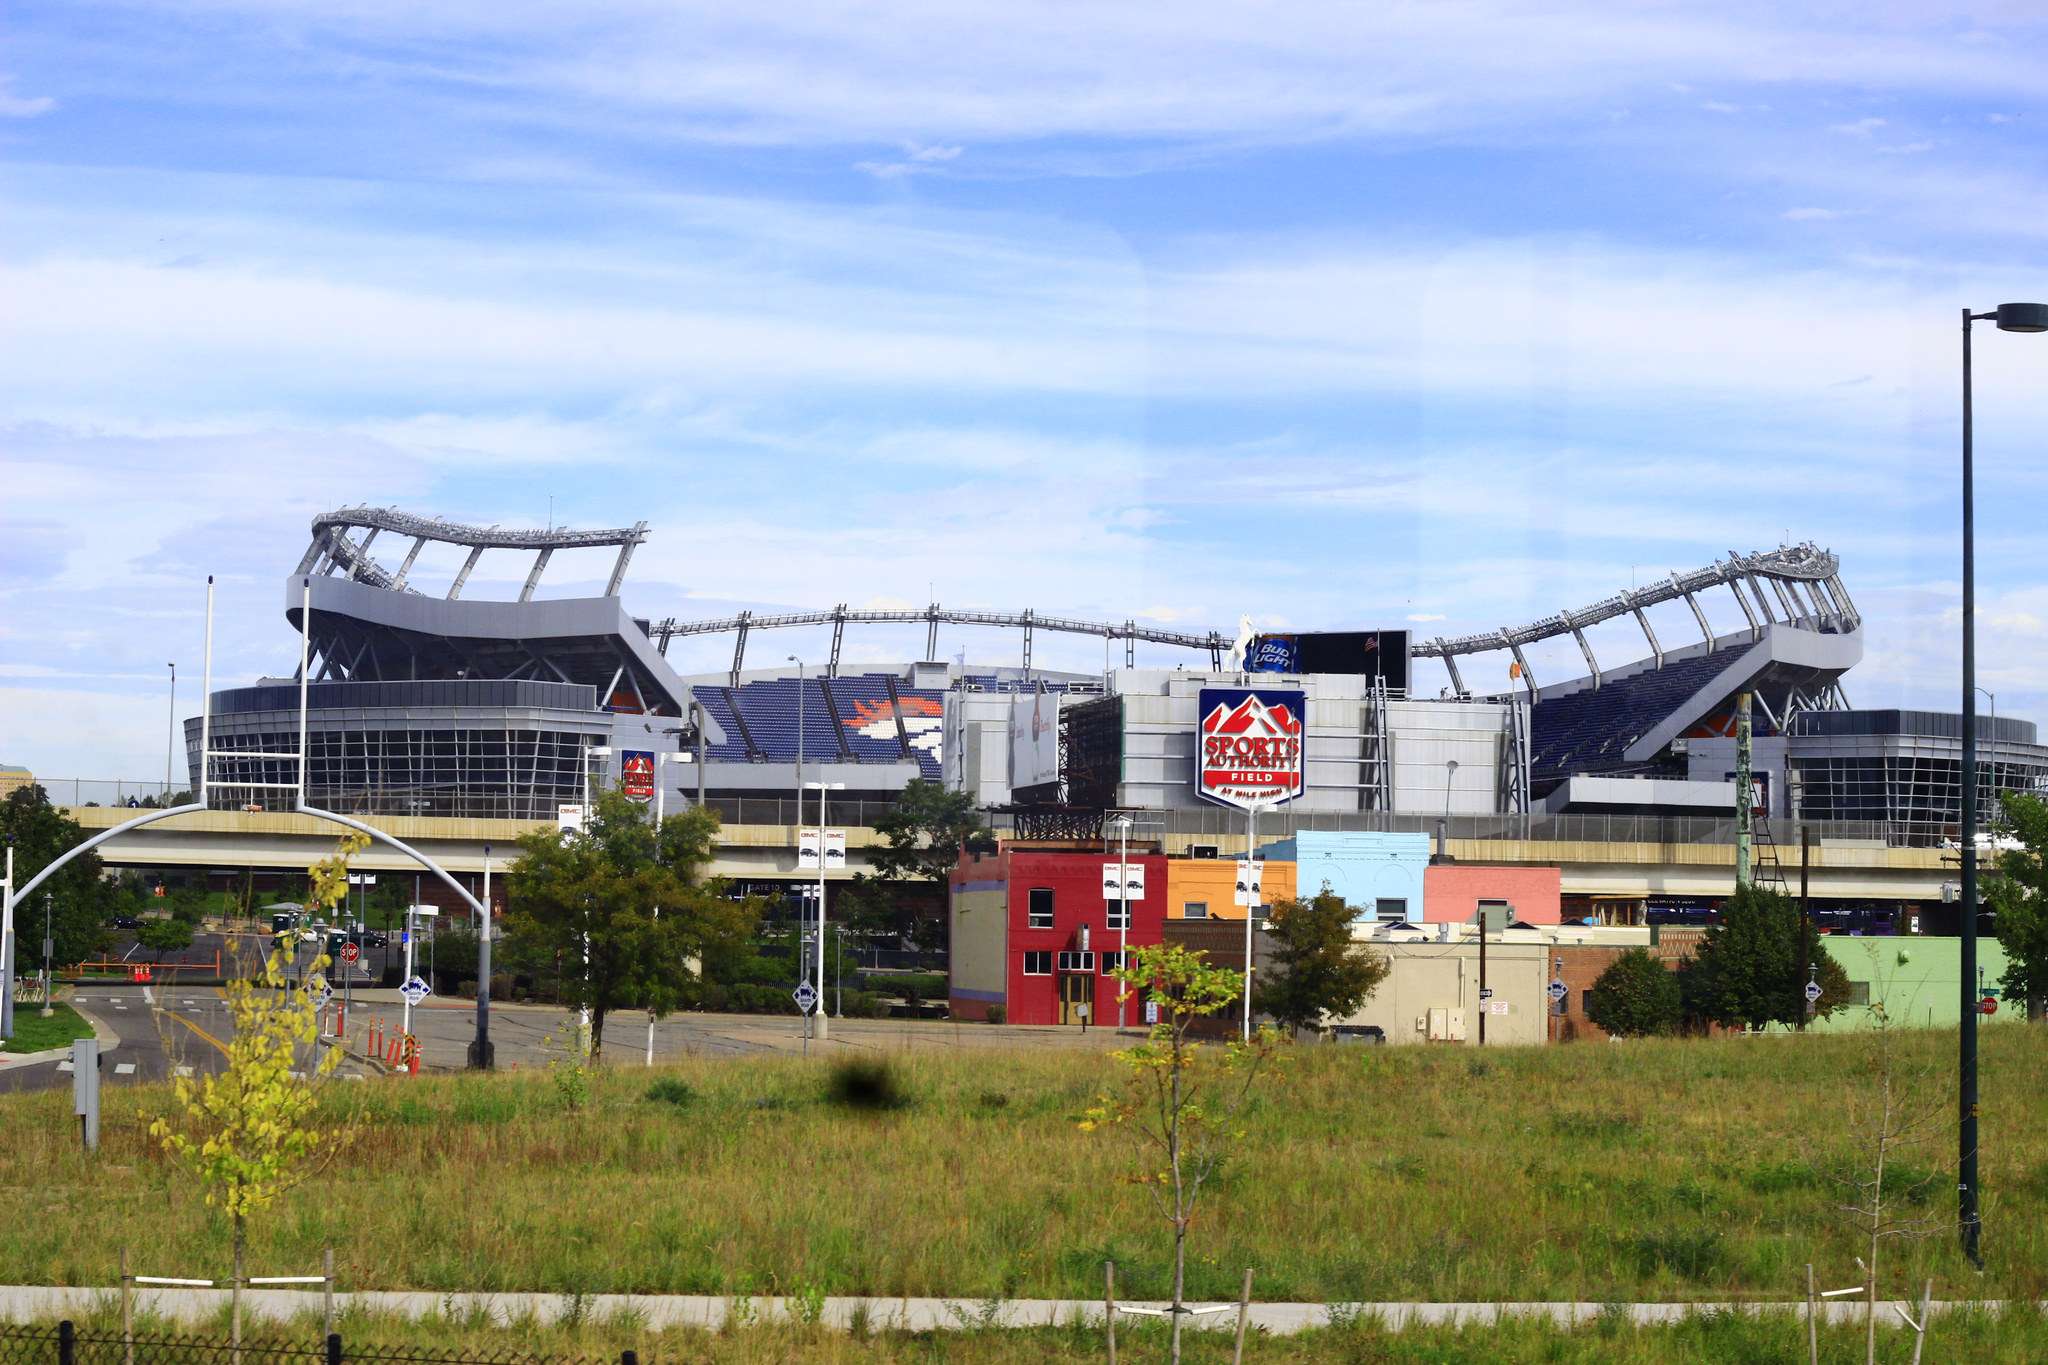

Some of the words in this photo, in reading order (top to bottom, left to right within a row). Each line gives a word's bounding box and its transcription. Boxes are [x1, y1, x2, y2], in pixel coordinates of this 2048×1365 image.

[1260, 643, 1290, 658] BUD
[1254, 653, 1290, 667] LIGHT
[1205, 736, 1299, 755] SPORTS
[1206, 755, 1298, 767] AUTHORITY
[1231, 773, 1273, 782] FIELD
